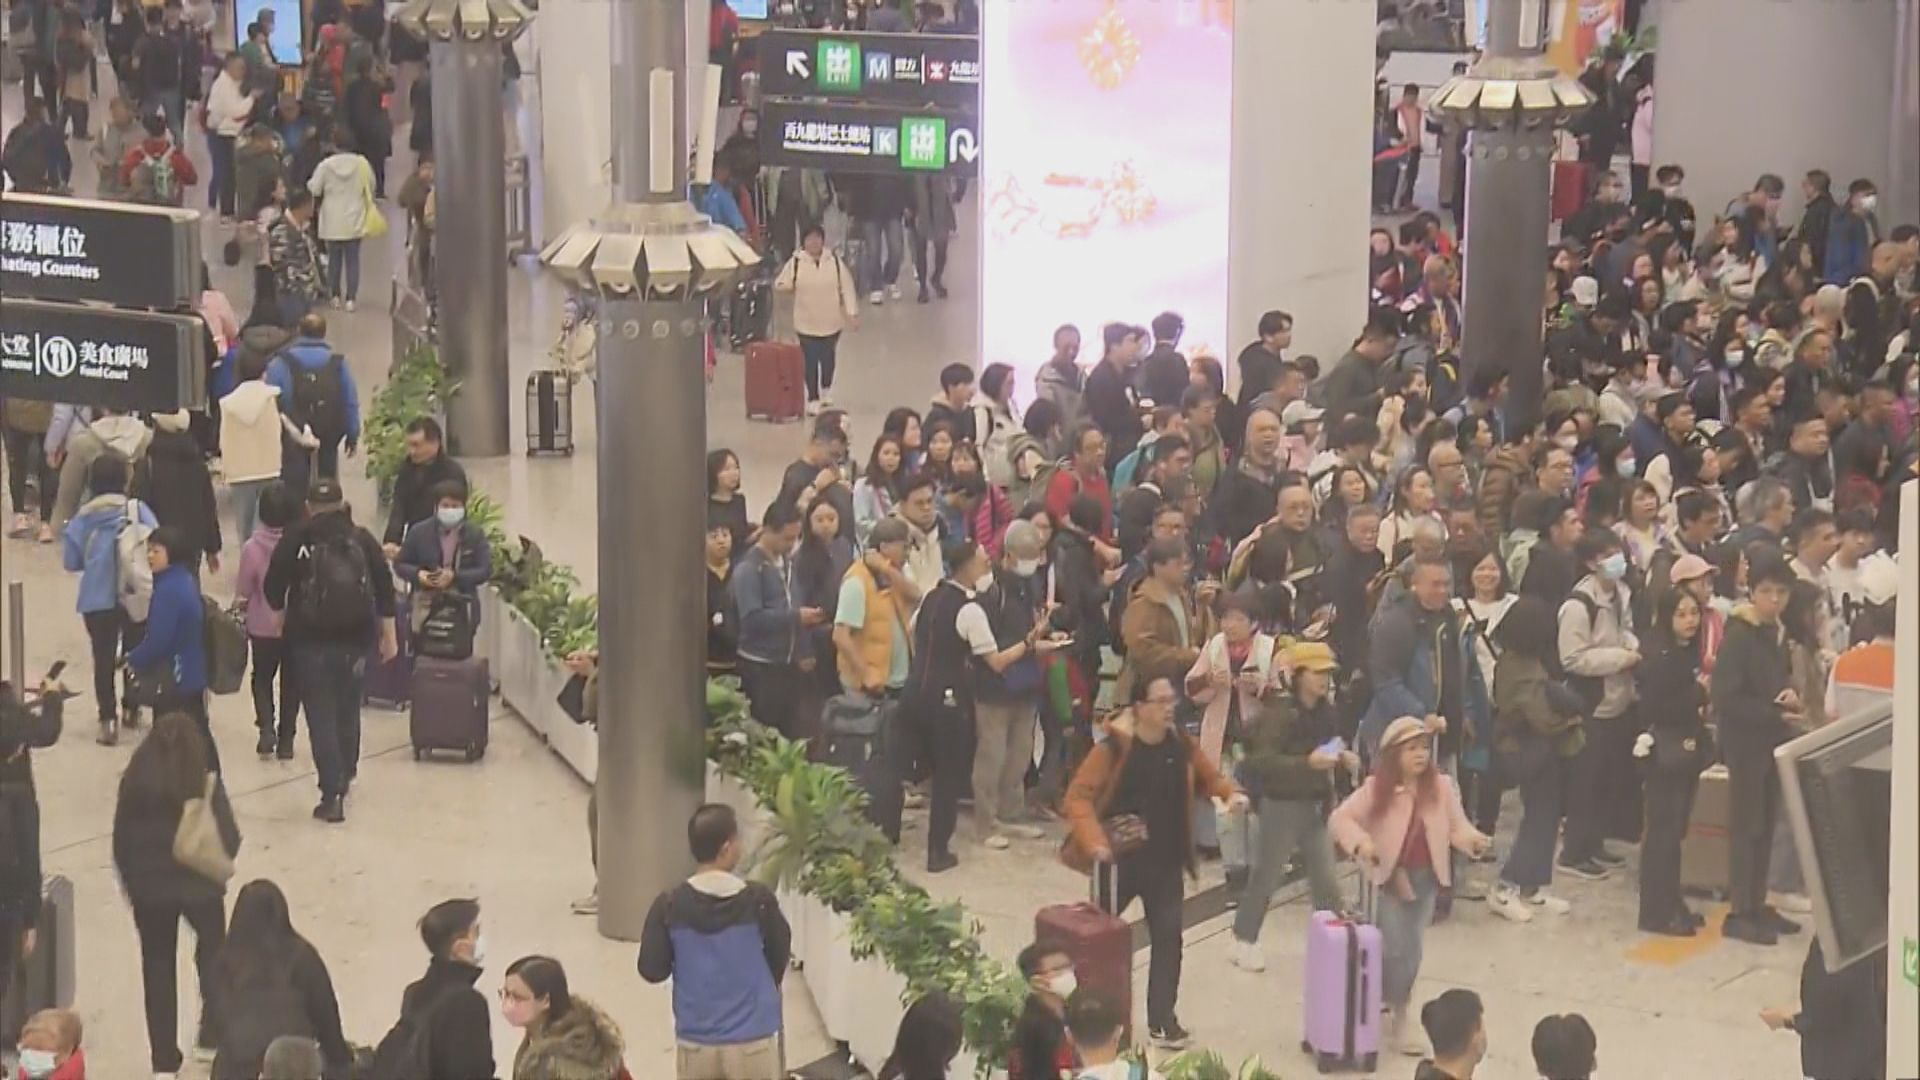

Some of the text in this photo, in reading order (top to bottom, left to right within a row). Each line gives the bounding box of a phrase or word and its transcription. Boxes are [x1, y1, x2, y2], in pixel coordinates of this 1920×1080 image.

[869, 57, 887, 80] M
[879, 131, 892, 152] K
[42, 259, 100, 280] Counters
[79, 340, 149, 369] 美食廣場
[103, 367, 129, 381] Court
